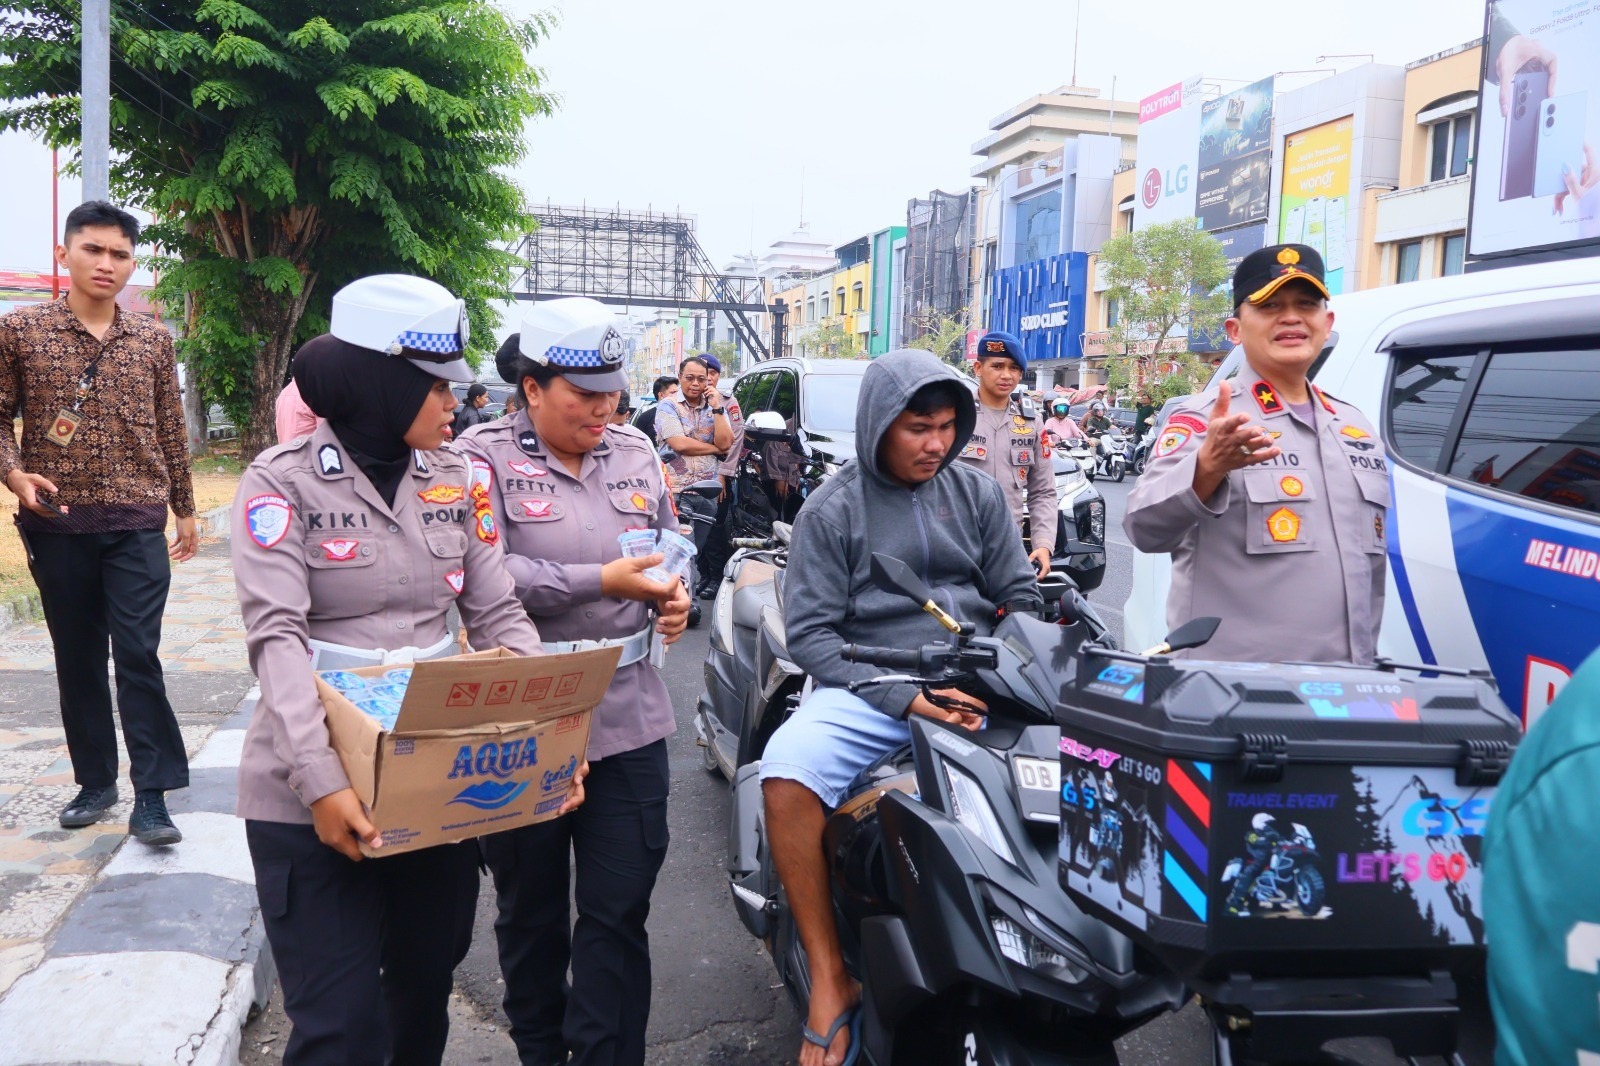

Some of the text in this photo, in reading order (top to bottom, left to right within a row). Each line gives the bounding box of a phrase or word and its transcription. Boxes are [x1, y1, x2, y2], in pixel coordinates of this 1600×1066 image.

[1141, 91, 1180, 118] POLYTRON
[1165, 164, 1188, 197] LG
[1041, 310, 1069, 328] CLINIC
[1350, 455, 1387, 473] POLRI
[506, 478, 556, 494] FETTY
[606, 478, 650, 492] POLRI
[308, 512, 368, 530] KIKI
[1384, 684, 1401, 694] GO
[447, 736, 538, 780] AQUA
[1021, 763, 1054, 788] DB
[1119, 756, 1143, 779] LET'S
[1144, 764, 1162, 785] GO
[1226, 792, 1338, 809] TRAVEL EVENT
[1336, 852, 1467, 883] LET'S GO
